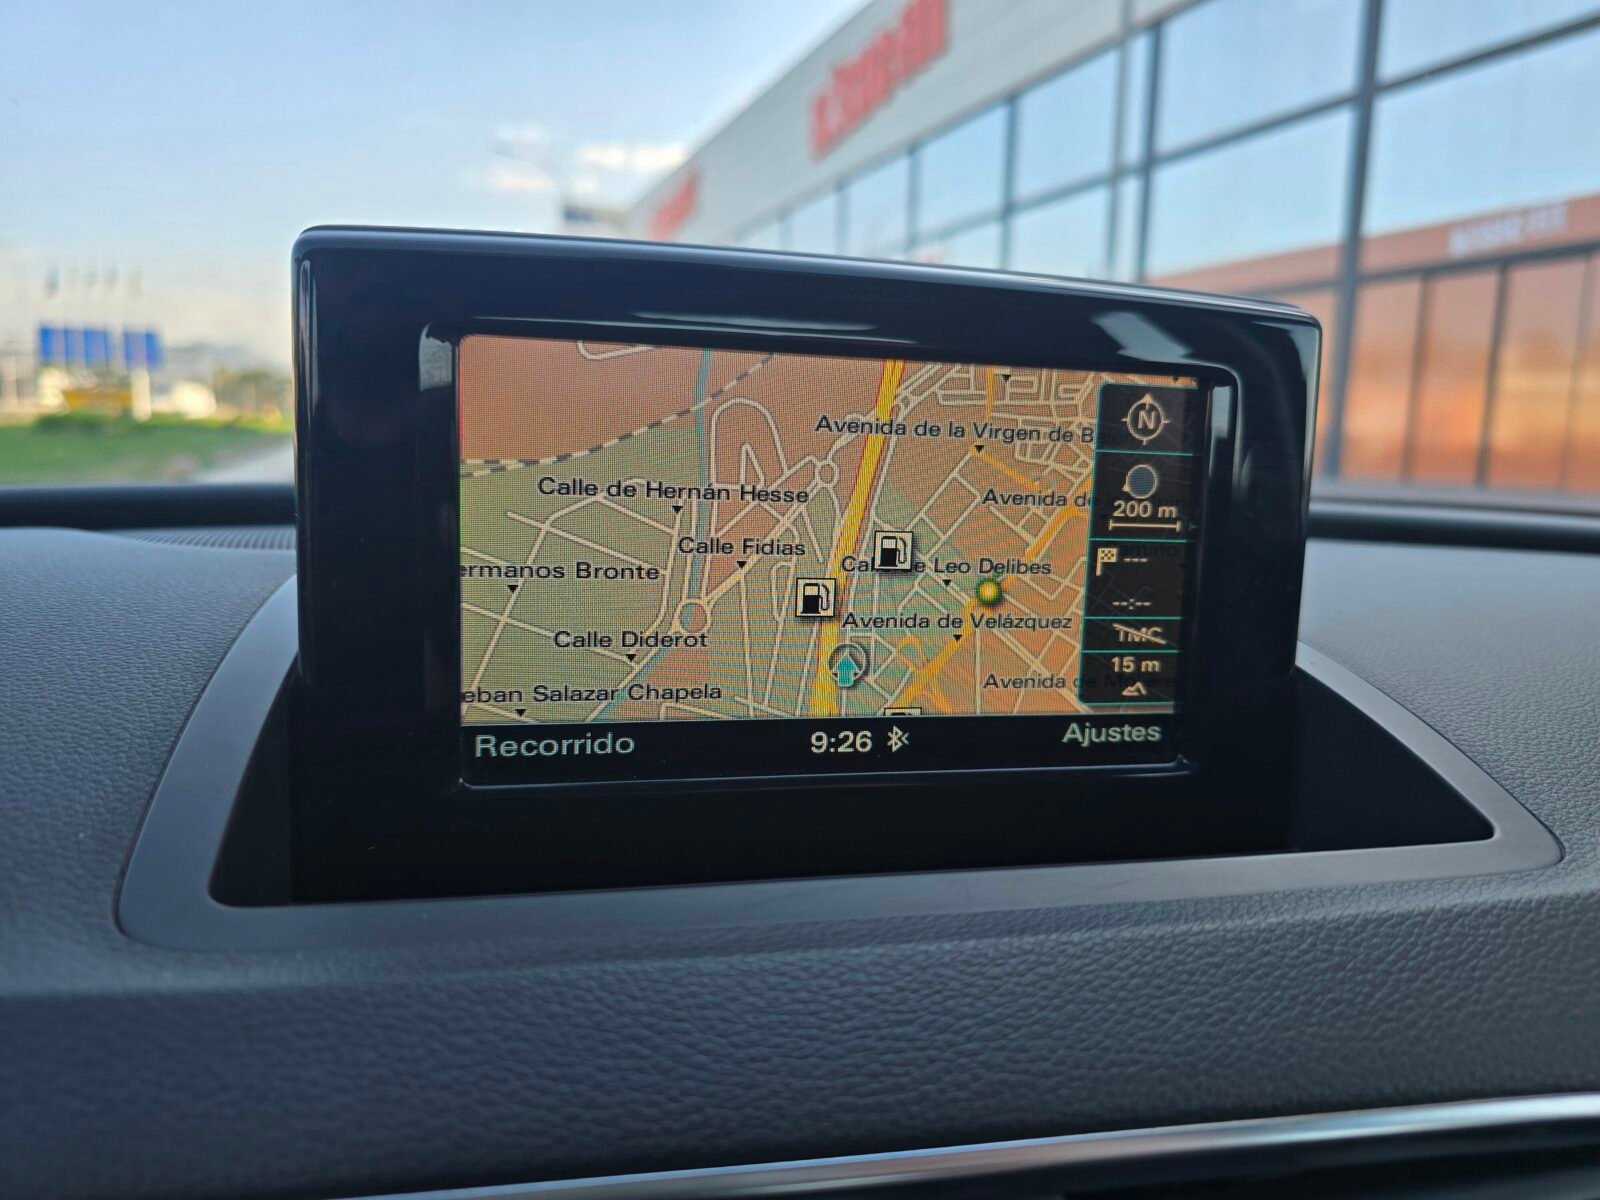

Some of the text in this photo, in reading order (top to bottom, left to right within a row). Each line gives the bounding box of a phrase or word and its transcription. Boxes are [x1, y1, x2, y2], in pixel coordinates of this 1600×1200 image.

[815, 415, 906, 435] Avenida
[915, 418, 940, 437] de
[949, 419, 965, 438] la
[973, 422, 1041, 444] Virgen
[1048, 423, 1074, 443] de
[1138, 411, 1155, 430] N
[538, 476, 809, 504] Calle de Hernán Hesse
[982, 488, 1067, 507] Avenida
[1112, 499, 1177, 518] 200 m
[678, 536, 806, 557] Calle Fidias
[576, 562, 660, 580] Bronte
[934, 557, 970, 575] Leo
[978, 557, 1052, 577] Delibes
[842, 611, 1074, 631] Avenida de Velázquez
[554, 630, 708, 649] Calle Diderot
[1111, 655, 1161, 674] 15 m
[984, 674, 1066, 689] Avenida
[533, 684, 620, 703] Salazar
[628, 683, 722, 704] Chapela
[474, 731, 635, 758] Recorrido
[810, 730, 873, 754] 9:26
[1061, 721, 1163, 748] Ajustes
